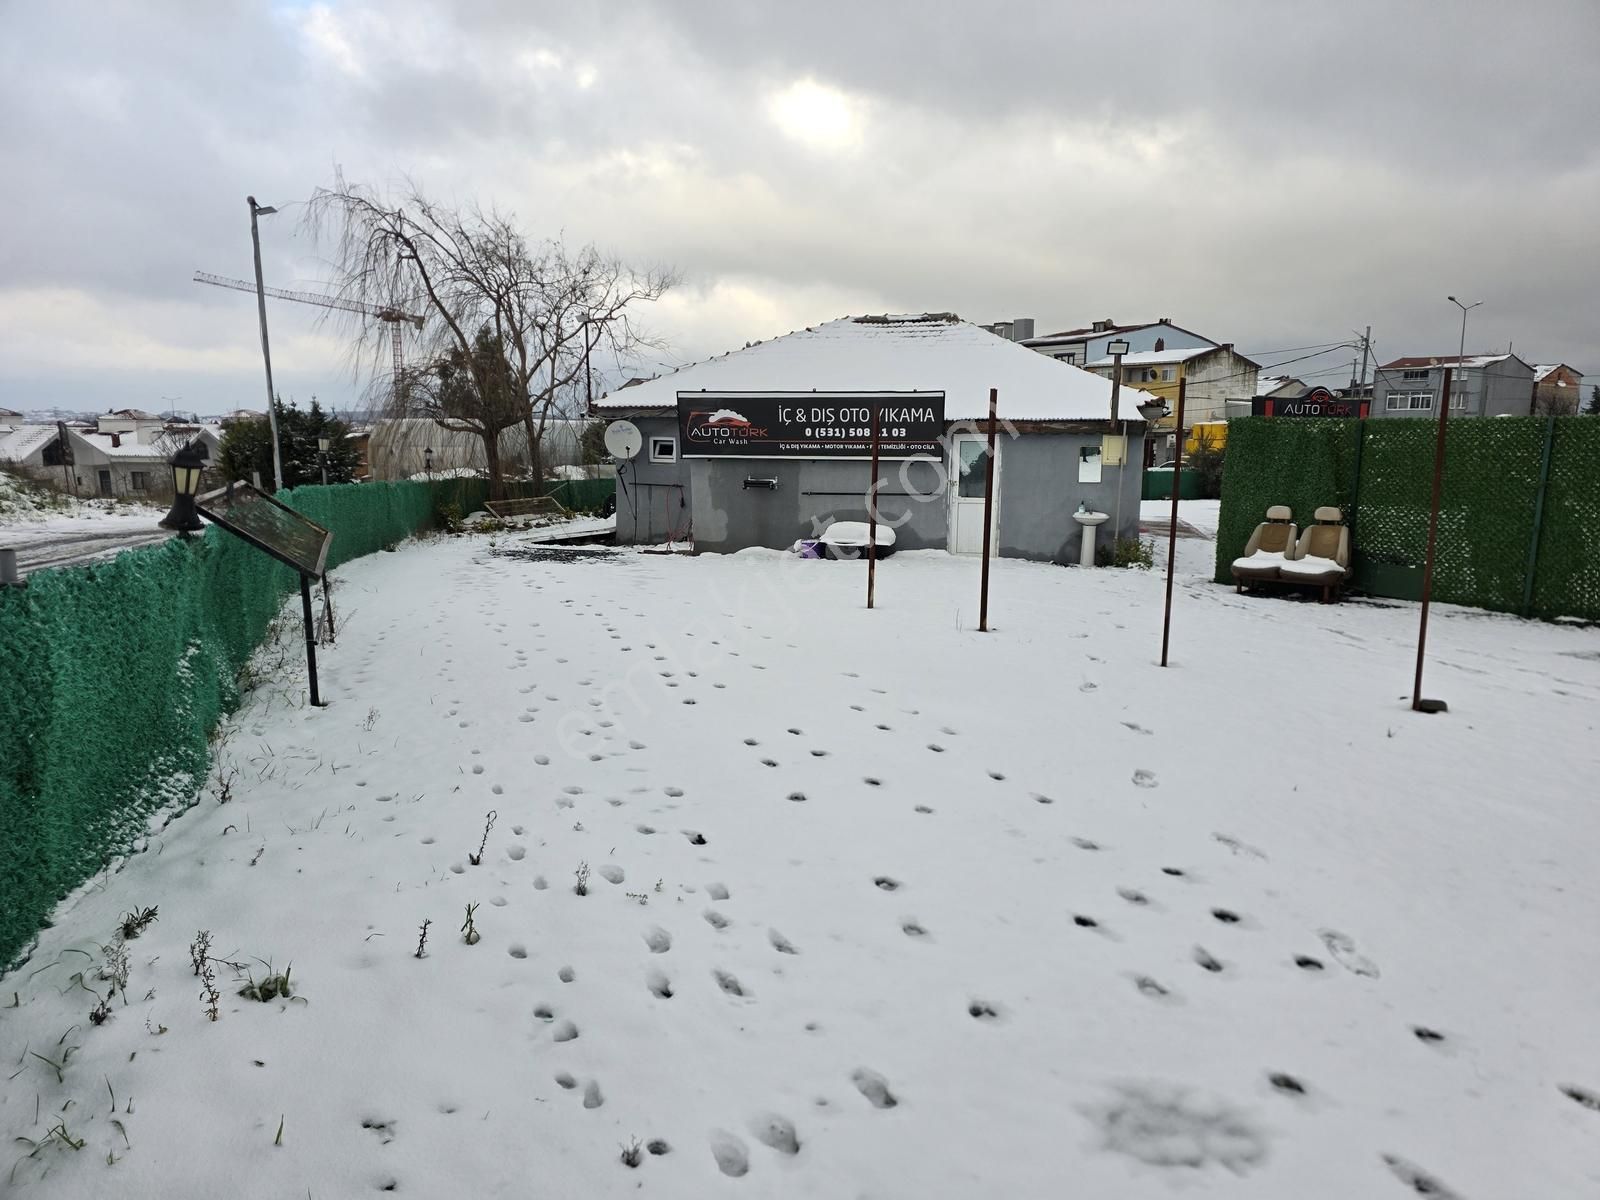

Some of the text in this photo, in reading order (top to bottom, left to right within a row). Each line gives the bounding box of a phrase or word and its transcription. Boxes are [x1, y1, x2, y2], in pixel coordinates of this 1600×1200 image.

[778, 405, 791, 425] İÇ
[796, 408, 806, 422] &
[811, 408, 835, 425] DIŞ
[839, 408, 870, 422] OTO
[805, 428, 906, 438] 0 (531) 508 1 03
